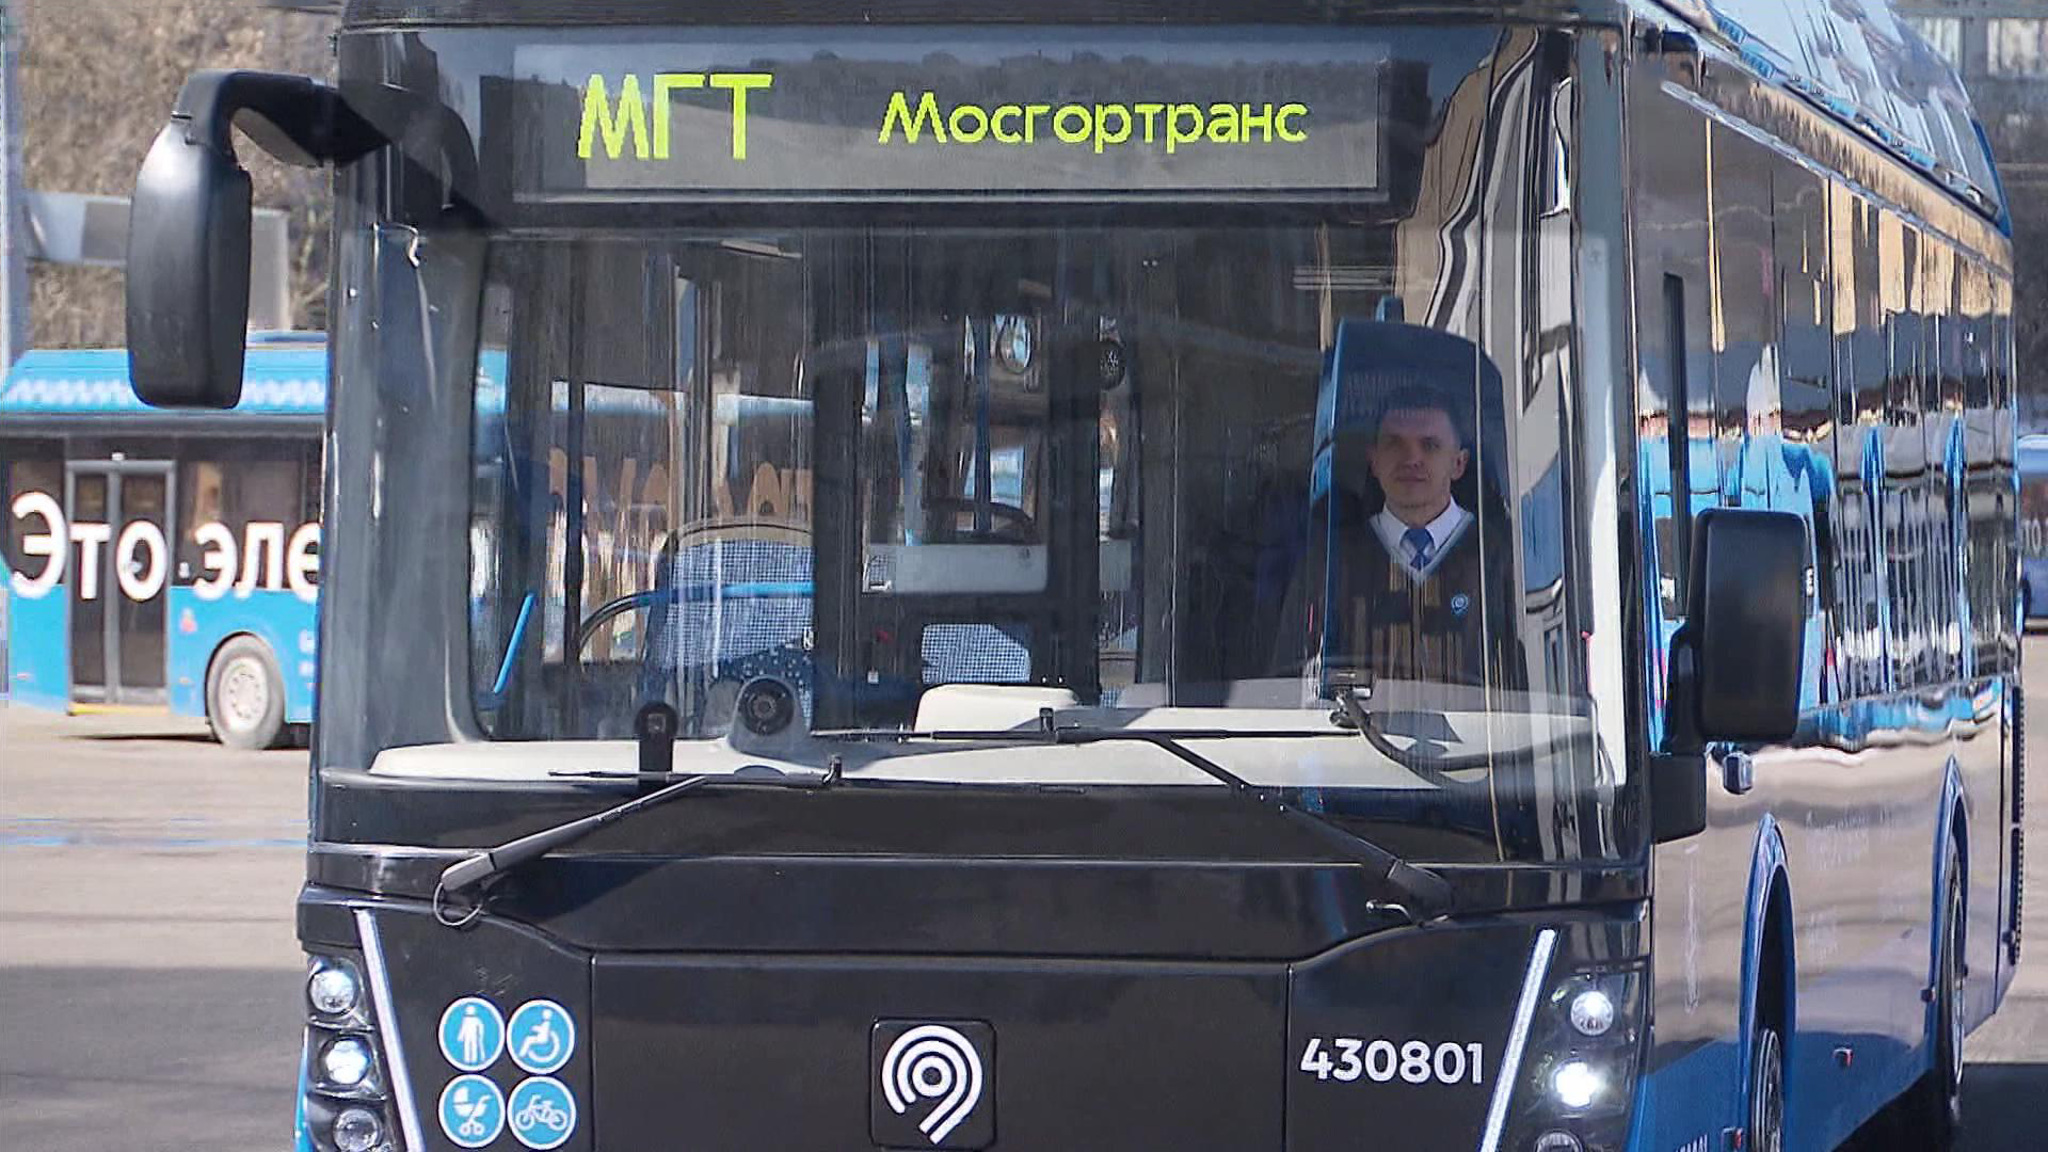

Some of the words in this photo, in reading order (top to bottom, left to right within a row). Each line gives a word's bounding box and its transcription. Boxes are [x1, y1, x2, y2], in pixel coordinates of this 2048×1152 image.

[577, 73, 773, 160] МГТ
[879, 91, 1308, 153] Мосгортранс
[11, 491, 169, 602] Это
[1300, 1037, 1484, 1084] 430801
